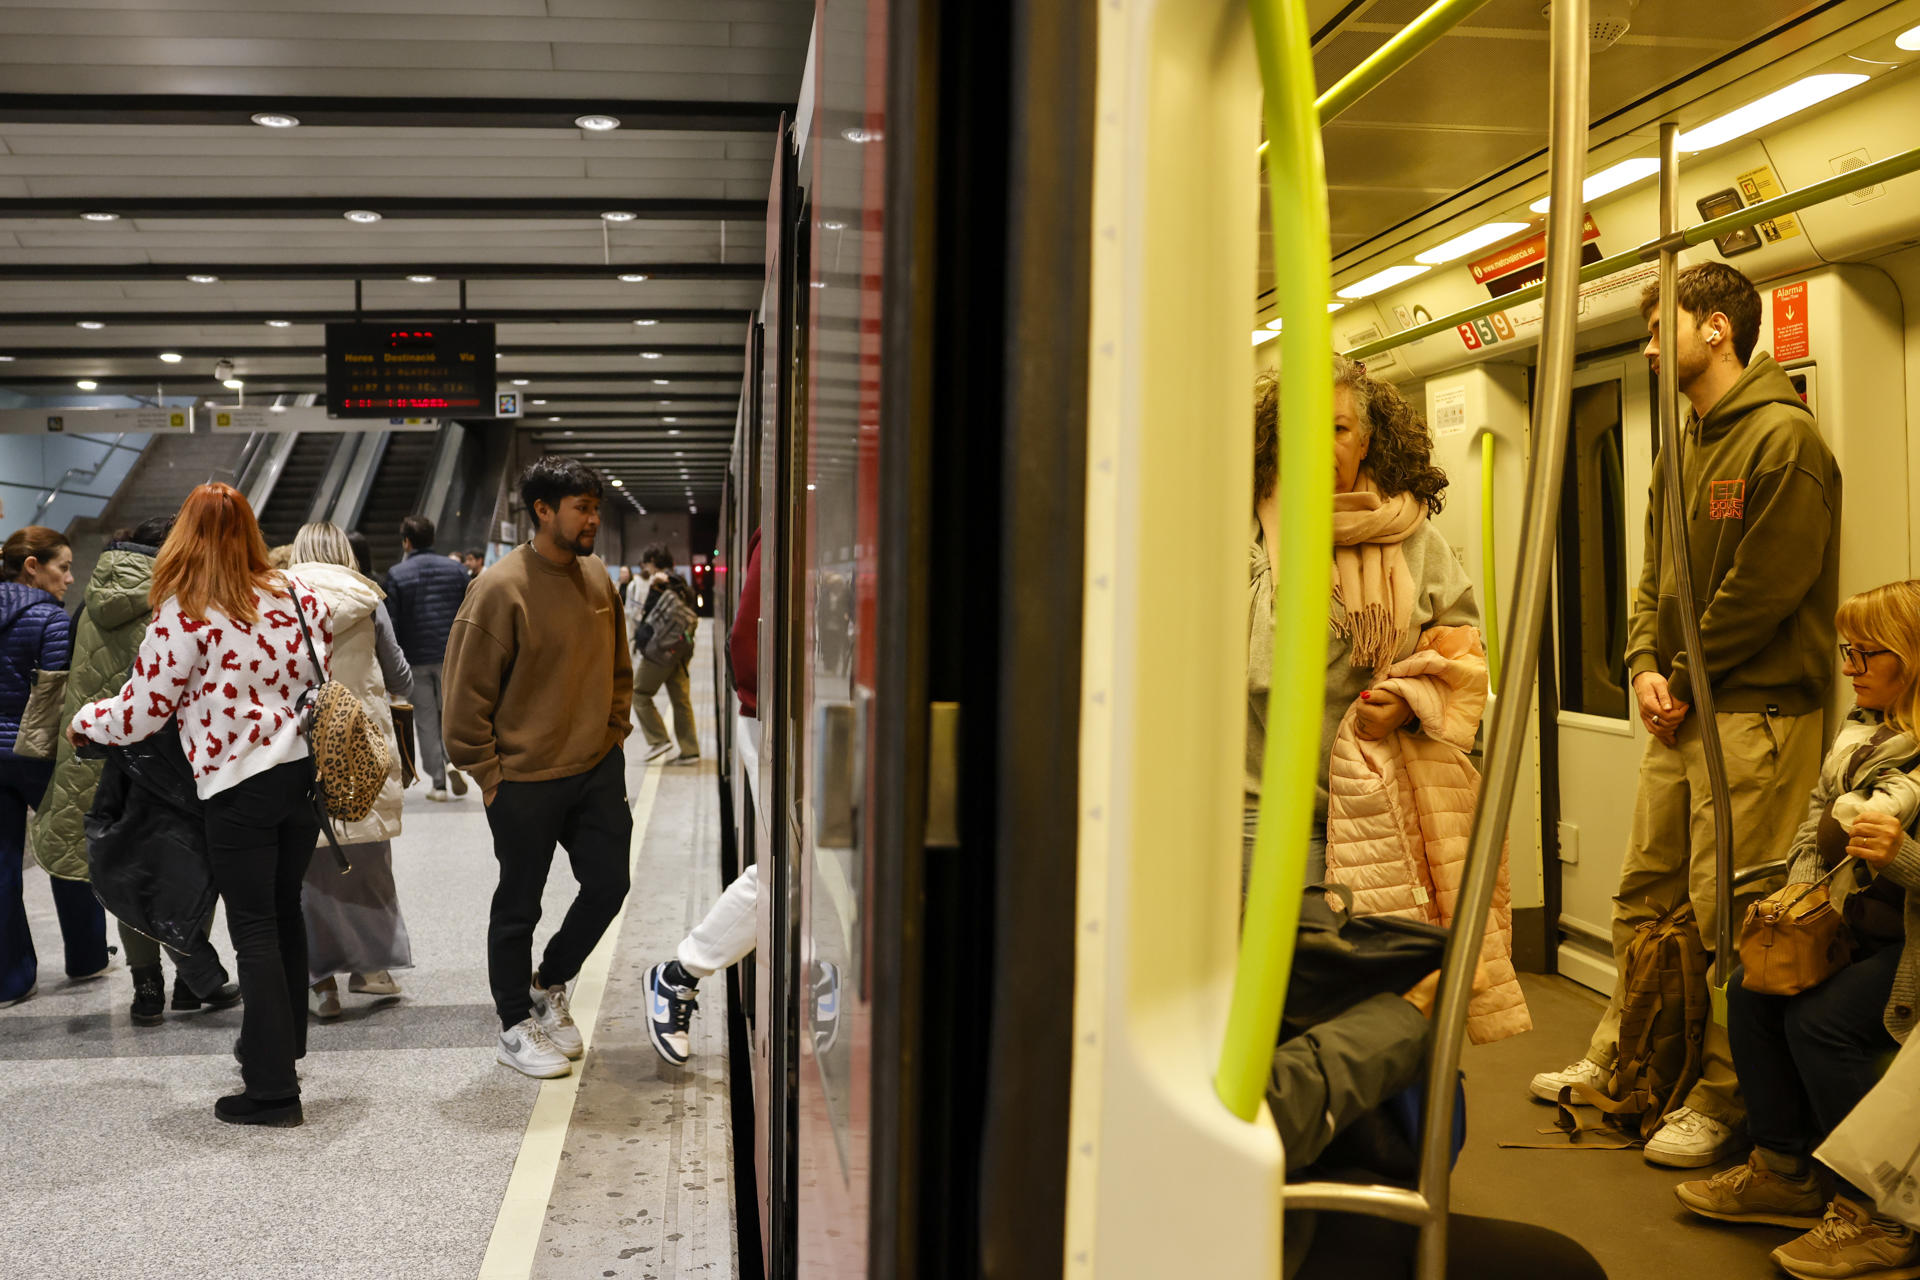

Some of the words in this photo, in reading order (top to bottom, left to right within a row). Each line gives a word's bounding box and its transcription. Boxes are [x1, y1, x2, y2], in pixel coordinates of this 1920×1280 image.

[1482, 246, 1536, 274] www.metrovalencia.es
[1776, 286, 1803, 298] Alarma
[1460, 325, 1476, 346] 3
[1477, 319, 1492, 341] 5
[1493, 314, 1508, 336] 9
